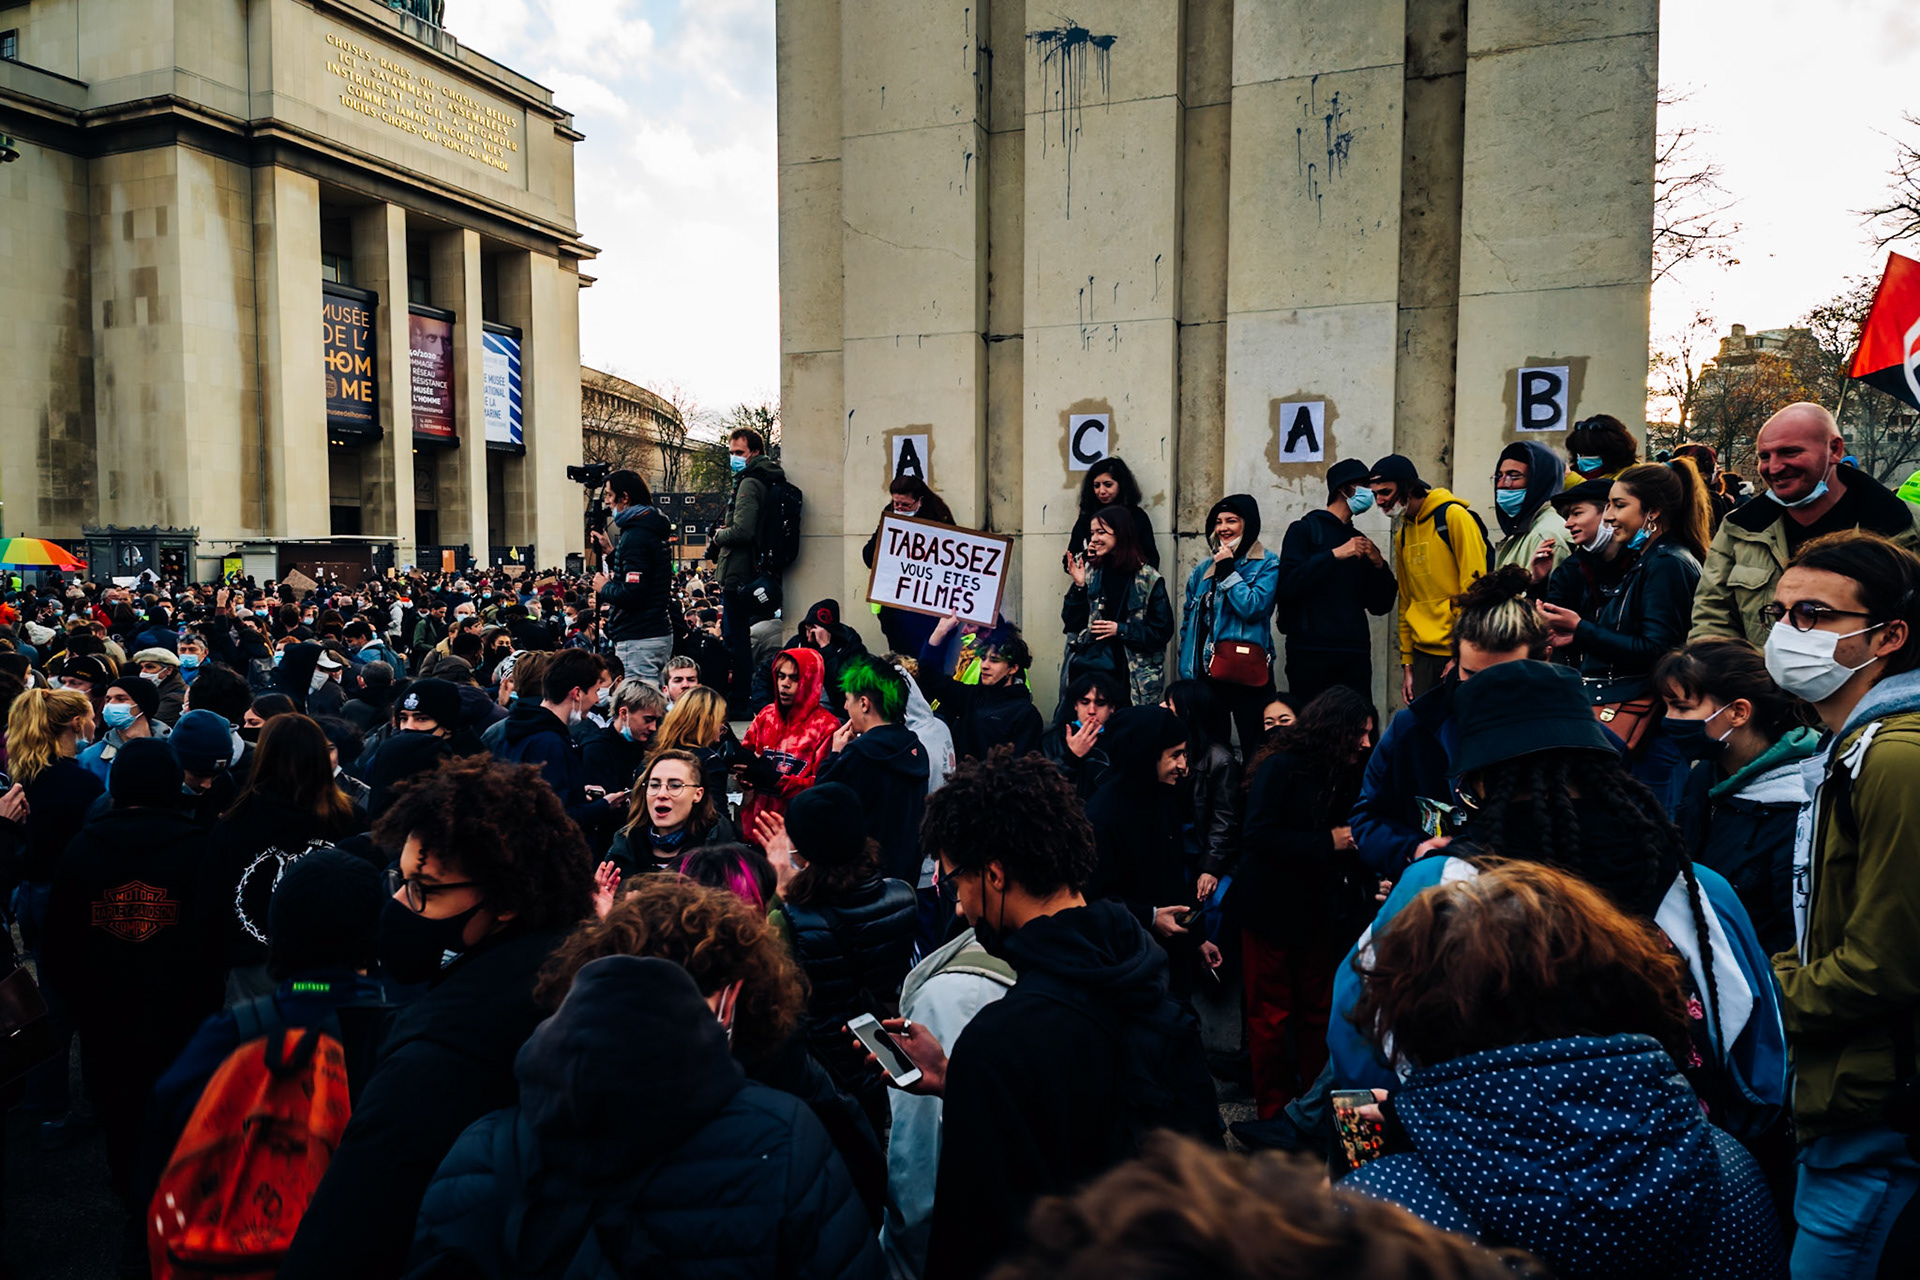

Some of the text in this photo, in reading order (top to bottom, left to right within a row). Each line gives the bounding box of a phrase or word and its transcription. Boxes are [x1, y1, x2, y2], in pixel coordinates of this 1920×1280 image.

[326, 33, 517, 128] CHOSES RARES OU CHOSES BELLES
[326, 60, 403, 102] INSTRUISENT
[452, 117, 458, 126] A
[467, 122, 517, 152] REGARDER
[338, 52, 508, 136] ICI SAVAMMENT ASSEMBLÉES
[339, 94, 509, 172] TOUTES CHOSES QUI SONT AU MONDE
[347, 84, 504, 158] COMME JAMAIS ENCORE VUES
[341, 377, 372, 402] ME
[411, 359, 434, 369] MMAGE
[484, 386, 506, 398] ATIONAL
[896, 371, 1562, 480] A C A B
[887, 527, 1001, 576] TABASSEZ
[901, 562, 981, 591] VOUS ETES
[115, 888, 155, 901] MOTOR
